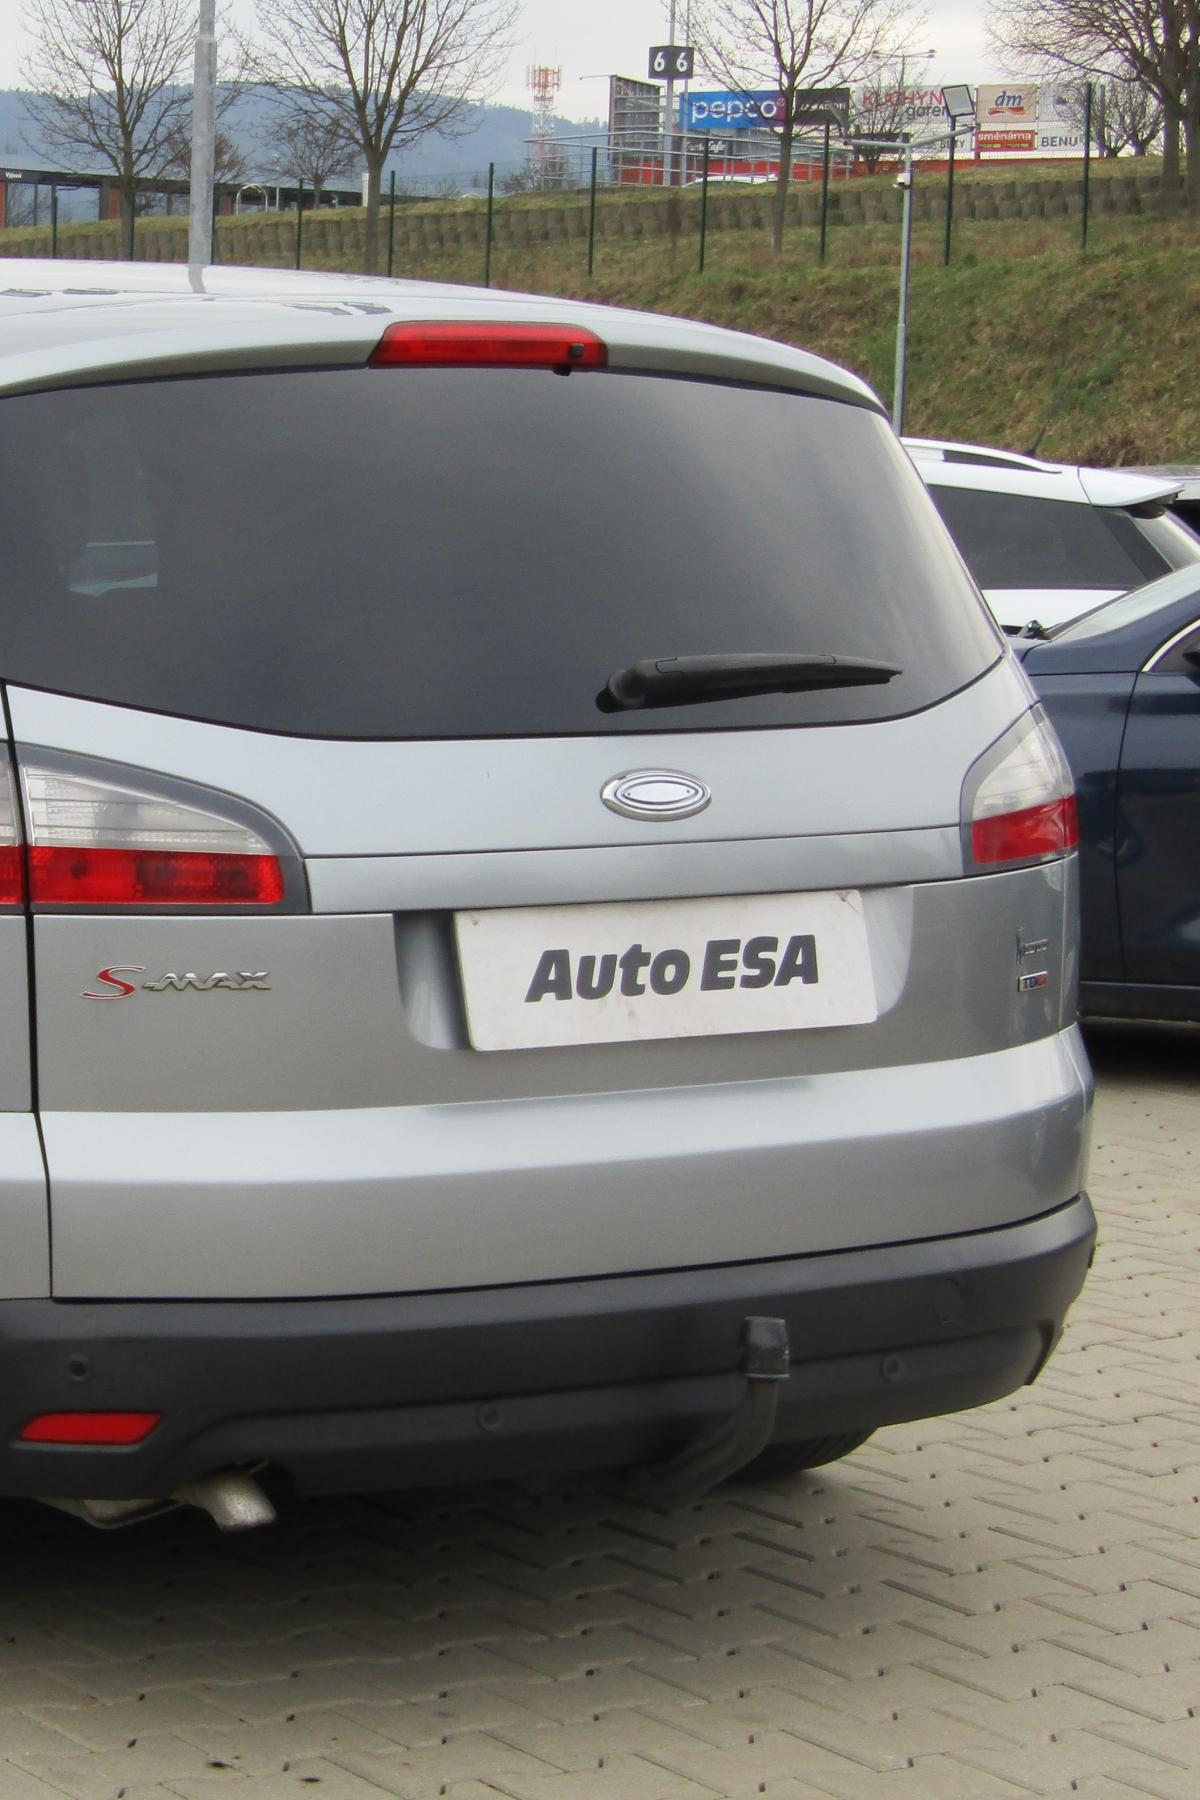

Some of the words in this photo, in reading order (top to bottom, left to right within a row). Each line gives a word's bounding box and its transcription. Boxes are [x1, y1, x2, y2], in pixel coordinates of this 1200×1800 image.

[654, 51, 665, 72] 6
[676, 51, 688, 73] 6
[994, 90, 1022, 107] dm
[692, 99, 777, 123] pepco
[1041, 136, 1079, 148] BENU
[524, 943, 690, 1003] Auto
[700, 934, 819, 991] ESA
